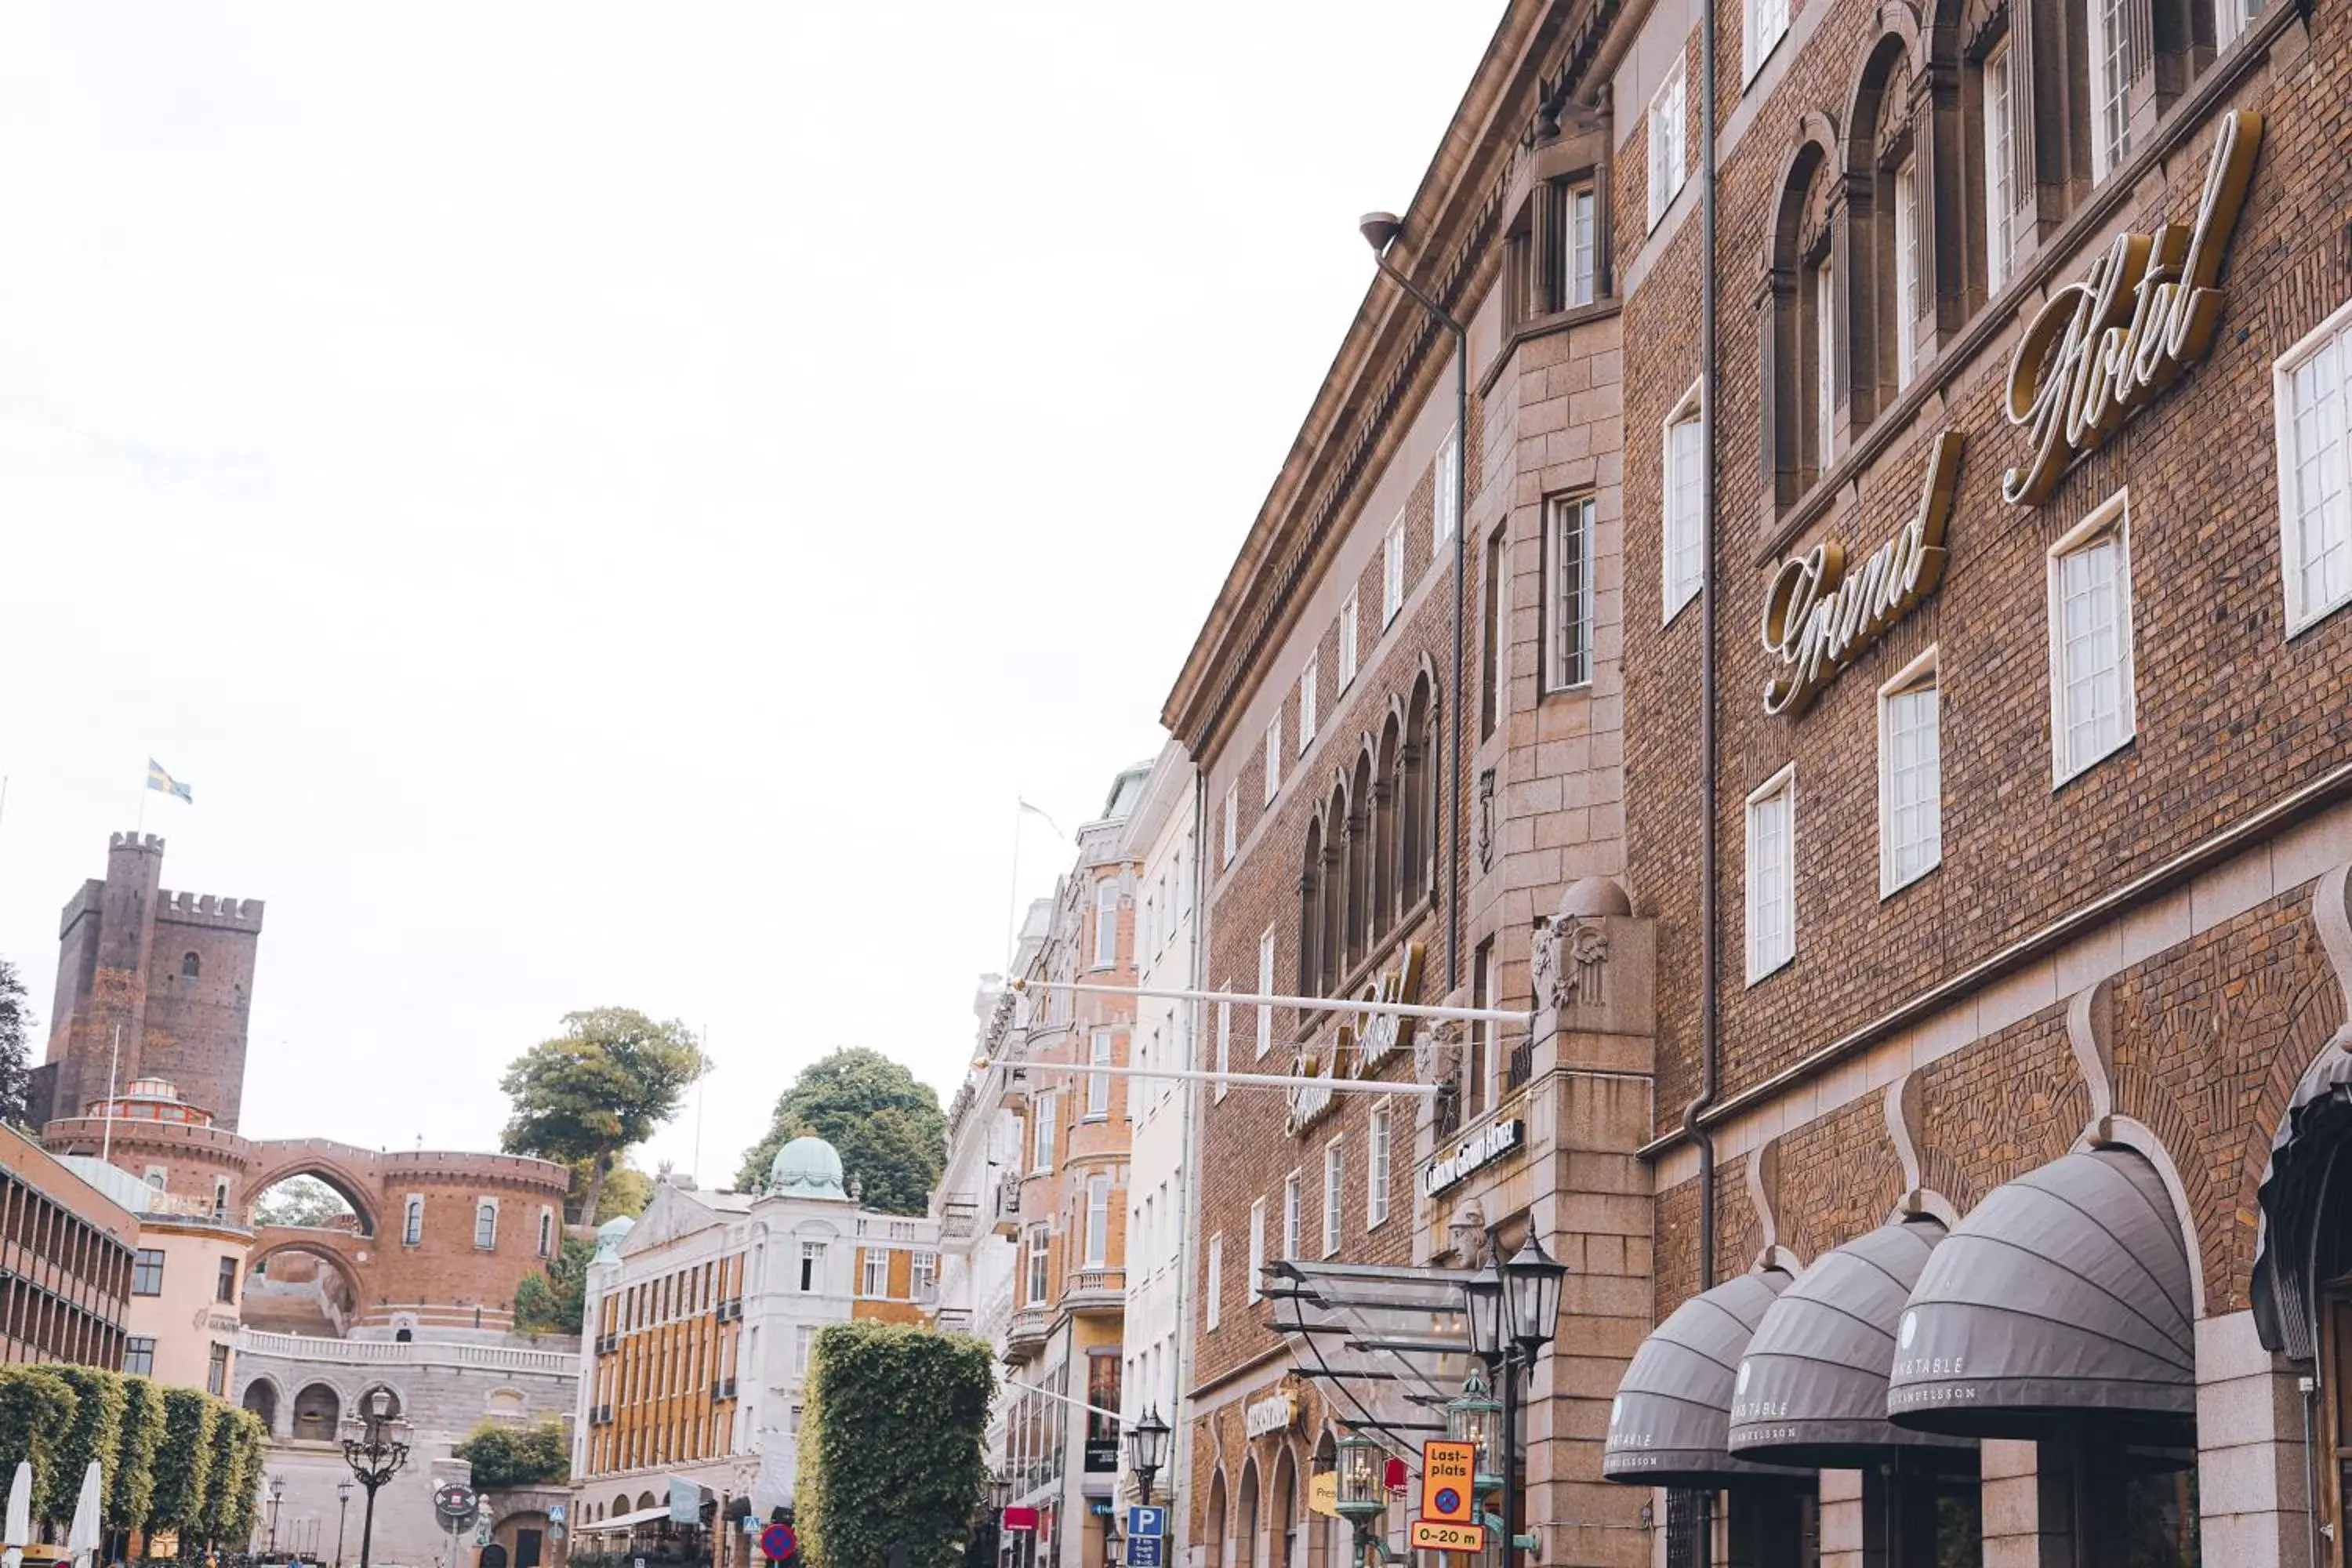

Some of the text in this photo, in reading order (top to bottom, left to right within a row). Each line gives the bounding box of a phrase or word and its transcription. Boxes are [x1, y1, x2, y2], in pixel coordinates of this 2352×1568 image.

[1762, 109, 2249, 715] Grand Hotel
[1431, 1448, 1468, 1461] Last-
[1430, 1464, 1466, 1477] plats
[1138, 1510, 1155, 1533] P
[1420, 1528, 1475, 1544] 0-20 m
